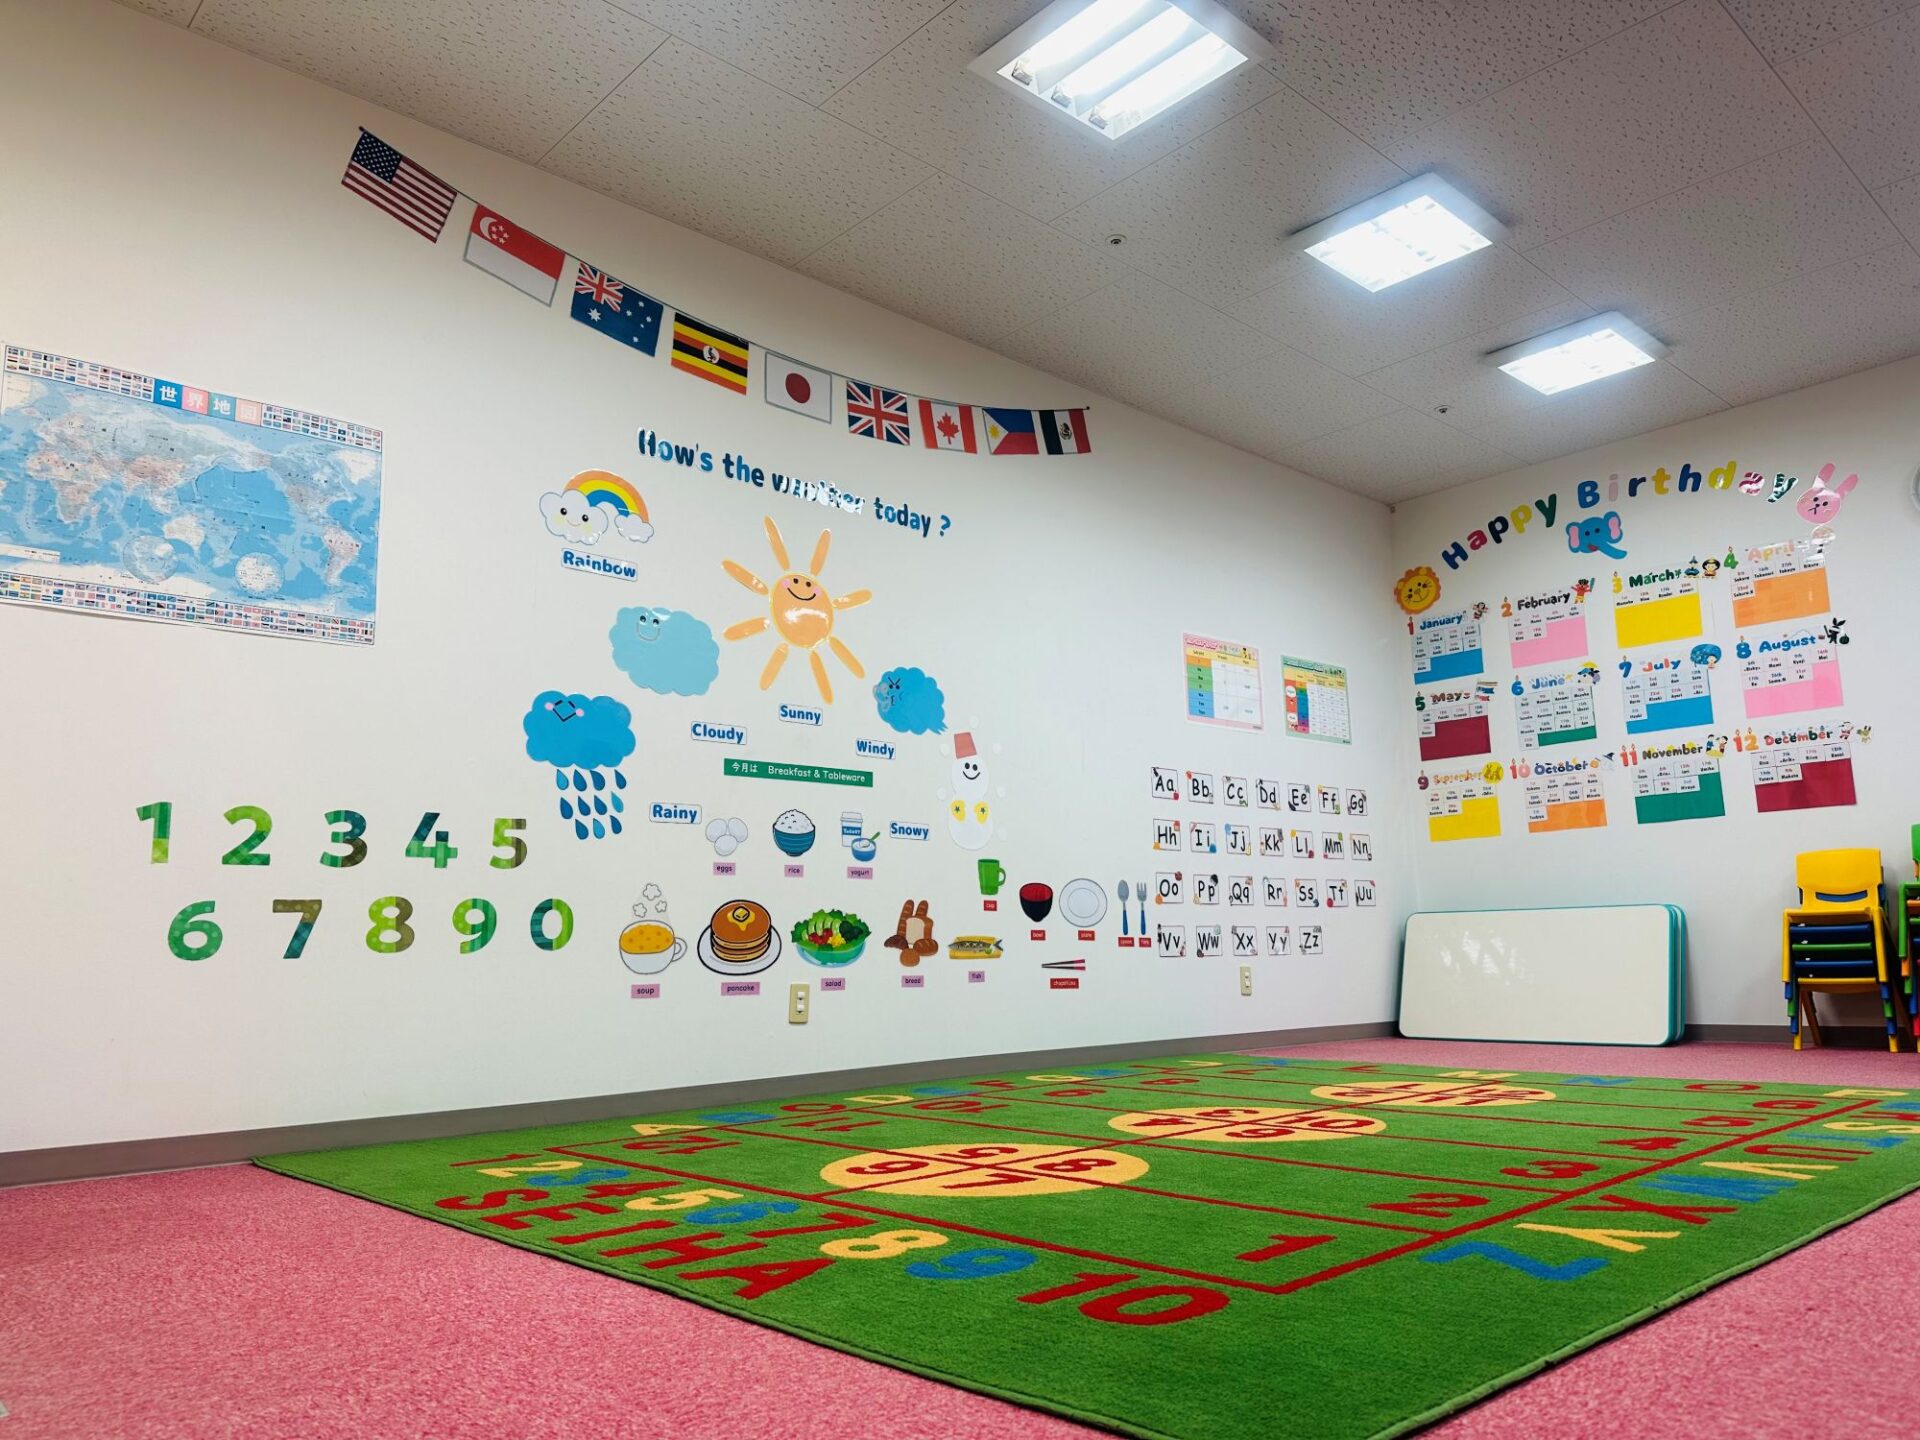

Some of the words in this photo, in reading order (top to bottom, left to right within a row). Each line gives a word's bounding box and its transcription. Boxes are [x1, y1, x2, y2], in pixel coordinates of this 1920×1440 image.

[637, 428, 713, 472] How's
[722, 453, 765, 488] the
[873, 497, 931, 538] today
[939, 514, 951, 537] ?
[1441, 493, 1557, 570] Happy
[1577, 460, 1799, 508] Birthday
[563, 550, 636, 578] Rainbow
[1629, 569, 1674, 588] March
[1501, 603, 1512, 617] 2
[1517, 593, 1570, 611] February
[1420, 614, 1463, 631] January
[1736, 642, 1751, 659] 8
[1759, 635, 1816, 652] August
[1619, 661, 1632, 678] 7
[1643, 658, 1681, 672] July
[1512, 681, 1524, 695] 6
[1532, 678, 1565, 689] June
[1415, 697, 1426, 711] 5
[1431, 692, 1462, 703] May
[780, 705, 821, 724] Sunny
[692, 723, 744, 744] Cloudy
[1733, 735, 1759, 752] 12
[1764, 730, 1833, 746] December
[857, 740, 894, 759] Windy
[1642, 744, 1703, 760] November
[732, 762, 758, 773] 今月は
[768, 766, 811, 778] Breakfast
[814, 770, 820, 778] &
[823, 771, 865, 782] Tableware
[1510, 764, 1530, 779] 10
[1535, 761, 1589, 775] October
[1418, 776, 1429, 790] 9
[1155, 775, 1174, 792] Aa
[1192, 778, 1210, 797] Bb
[1227, 783, 1244, 799] Cc
[1260, 786, 1276, 803] Dd
[1292, 789, 1307, 806] Ee
[1322, 792, 1336, 810] Ff
[1350, 795, 1364, 813] Gg
[653, 804, 698, 823] Rainy
[136, 801, 172, 864] 1
[221, 805, 273, 865] 2
[320, 809, 368, 868] 3
[405, 812, 458, 868] 4
[489, 818, 528, 869] 5
[891, 823, 930, 839] Snowy
[1158, 825, 1177, 846] Hh
[1230, 831, 1245, 852] Jj
[1265, 834, 1280, 851] Kk
[1325, 838, 1342, 854] Mm
[1353, 840, 1368, 855] Nn
[716, 865, 733, 873] eggs
[1160, 879, 1178, 897] Oo
[1198, 881, 1215, 902] Pp
[1232, 883, 1249, 903] Qq
[1267, 884, 1282, 900] Rr
[1299, 886, 1314, 901] Ss
[1329, 886, 1343, 901] Tt
[1358, 886, 1372, 901] Uu
[167, 900, 223, 961] 6
[272, 899, 322, 959] 7
[365, 896, 415, 954] 8
[452, 897, 497, 954] 9
[530, 897, 574, 951] 0
[1163, 932, 1180, 951] Vv
[1198, 933, 1219, 950] Ww
[1236, 933, 1254, 950] Xx
[1268, 932, 1287, 952] Yy
[1303, 932, 1319, 949] Zz
[477, 1161, 582, 1178] 2
[1033, 1159, 1117, 1173] 8
[525, 1168, 629, 1186] 3
[582, 1181, 684, 1199] 4
[624, 1189, 744, 1211] 5
[1367, 1193, 1490, 1219] 2
[1500, 1160, 1600, 1179] 3
[682, 1202, 799, 1225] 6
[1567, 1194, 1739, 1226] X
[746, 1212, 878, 1239] 7
[820, 1230, 949, 1259] 8
[1512, 1223, 1680, 1253] Y
[904, 1248, 1037, 1280] 9
[1419, 1241, 1607, 1283] Z
[1016, 1273, 1231, 1326] 10
